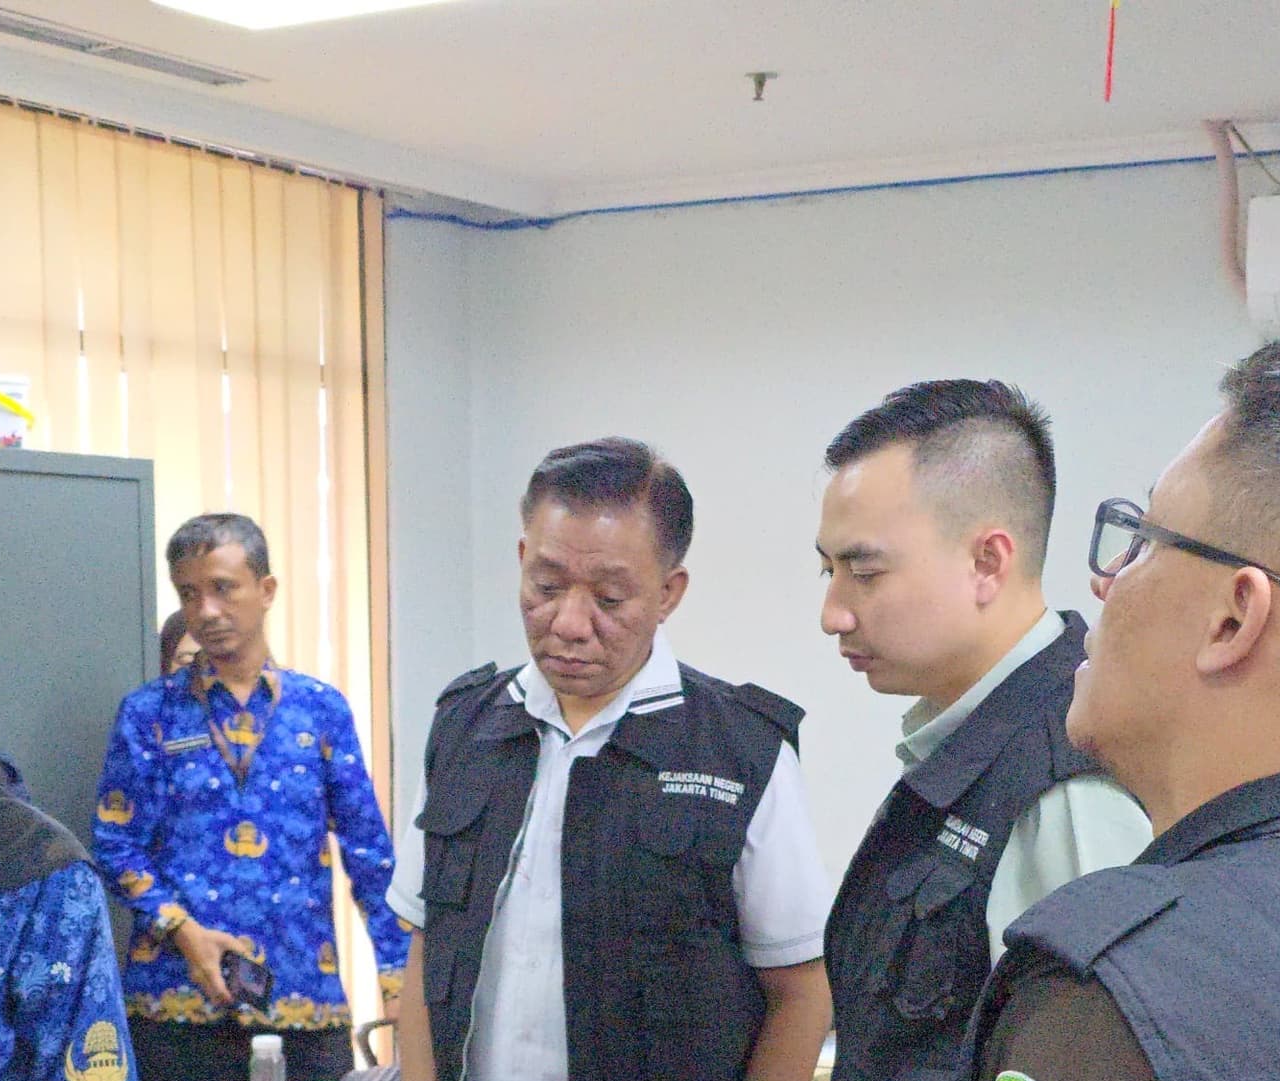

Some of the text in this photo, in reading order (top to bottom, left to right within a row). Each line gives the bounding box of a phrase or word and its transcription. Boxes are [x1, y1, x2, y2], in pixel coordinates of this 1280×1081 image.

[658, 771, 746, 794] KEJAKSAAN NEGERI
[662, 783, 738, 805] JAKARTA TIMUR
